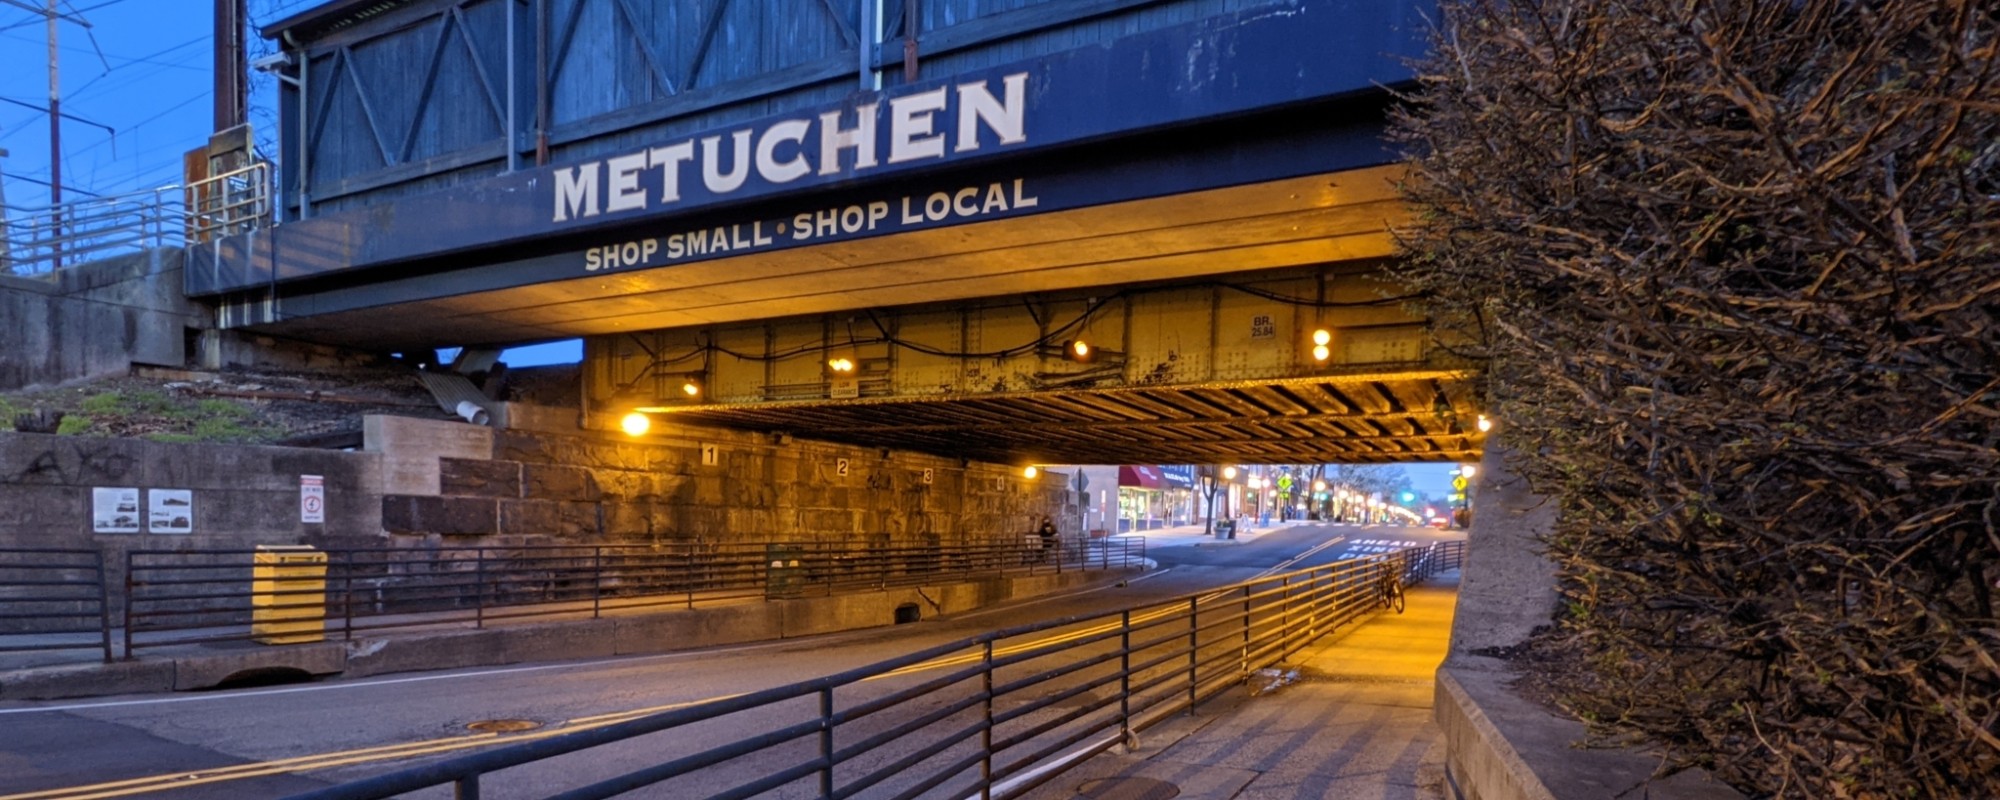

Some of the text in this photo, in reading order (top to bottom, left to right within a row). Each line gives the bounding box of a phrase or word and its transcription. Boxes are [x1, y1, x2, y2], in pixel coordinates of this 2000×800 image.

[552, 72, 1029, 223] METUCHEN
[584, 178, 1039, 271] SHOP SMALL SHOP LOCAL
[707, 447, 714, 464] 1
[838, 460, 847, 475] 2
[925, 470, 932, 482] 3
[1347, 545, 1402, 553] XING
[1349, 539, 1417, 547] AHEAD
